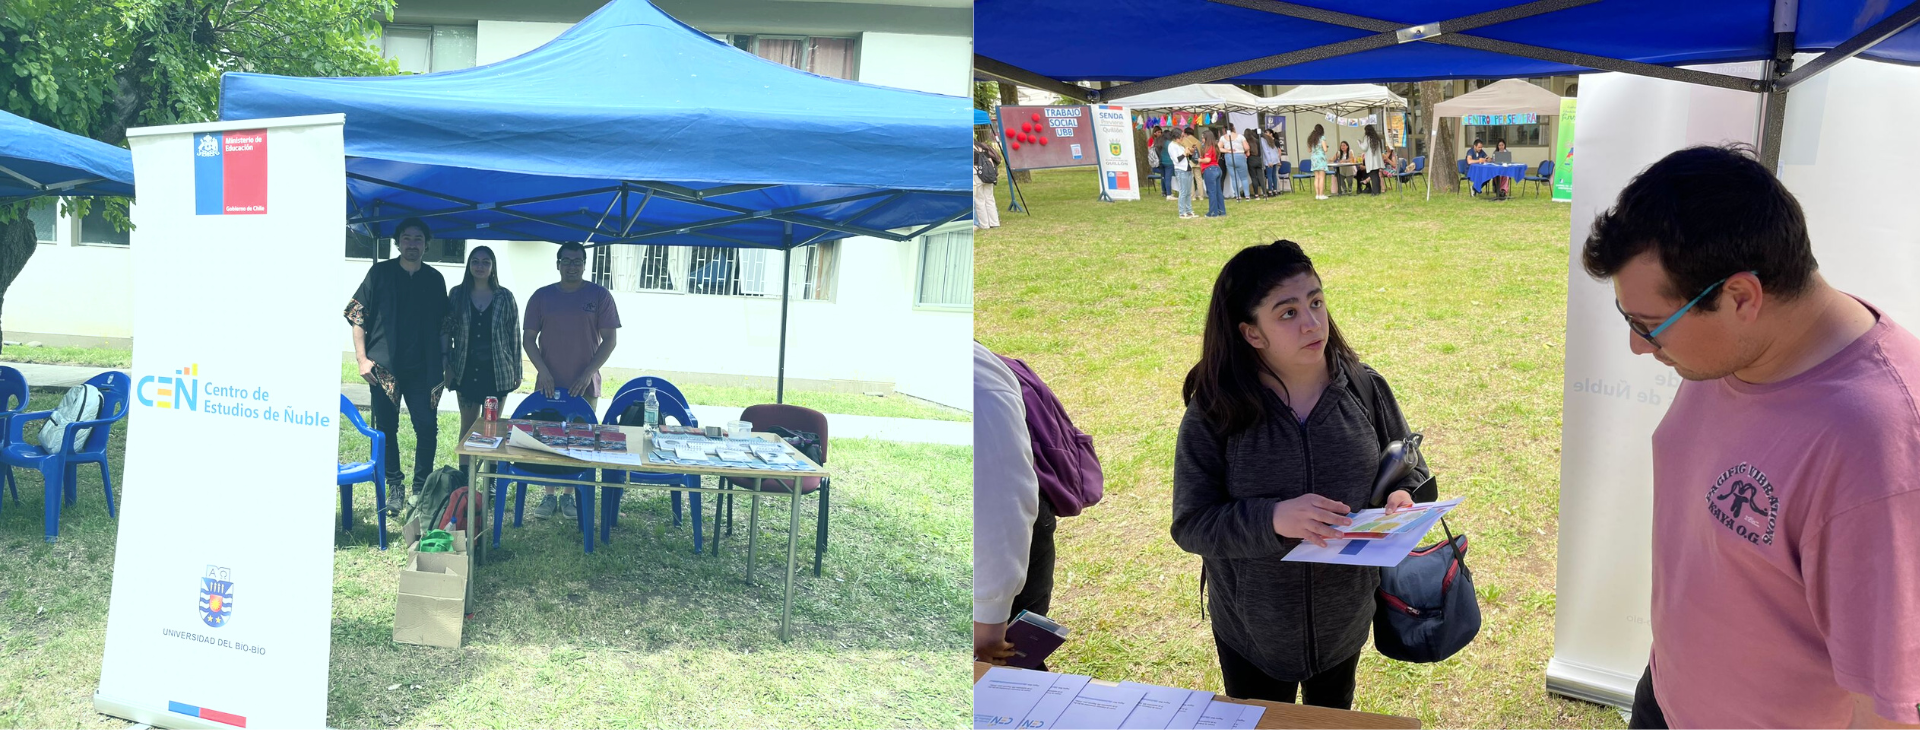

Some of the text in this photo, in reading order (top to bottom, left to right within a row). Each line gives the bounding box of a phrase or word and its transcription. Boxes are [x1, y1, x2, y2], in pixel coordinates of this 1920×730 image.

[1045, 108, 1081, 117] TRABAJO
[1099, 112, 1124, 120] SENDA
[1049, 118, 1078, 127] SOCIAL
[1056, 127, 1073, 137] UBB
[225, 144, 253, 152] Educación
[204, 382, 269, 401] Centro de
[204, 400, 330, 427] Estudios de Ñuble
[1747, 464, 1780, 546] VIBRATIONS
[1708, 501, 1735, 531] KAYA
[162, 628, 216, 645] UNIVERSIDAD
[217, 638, 233, 649] DEL
